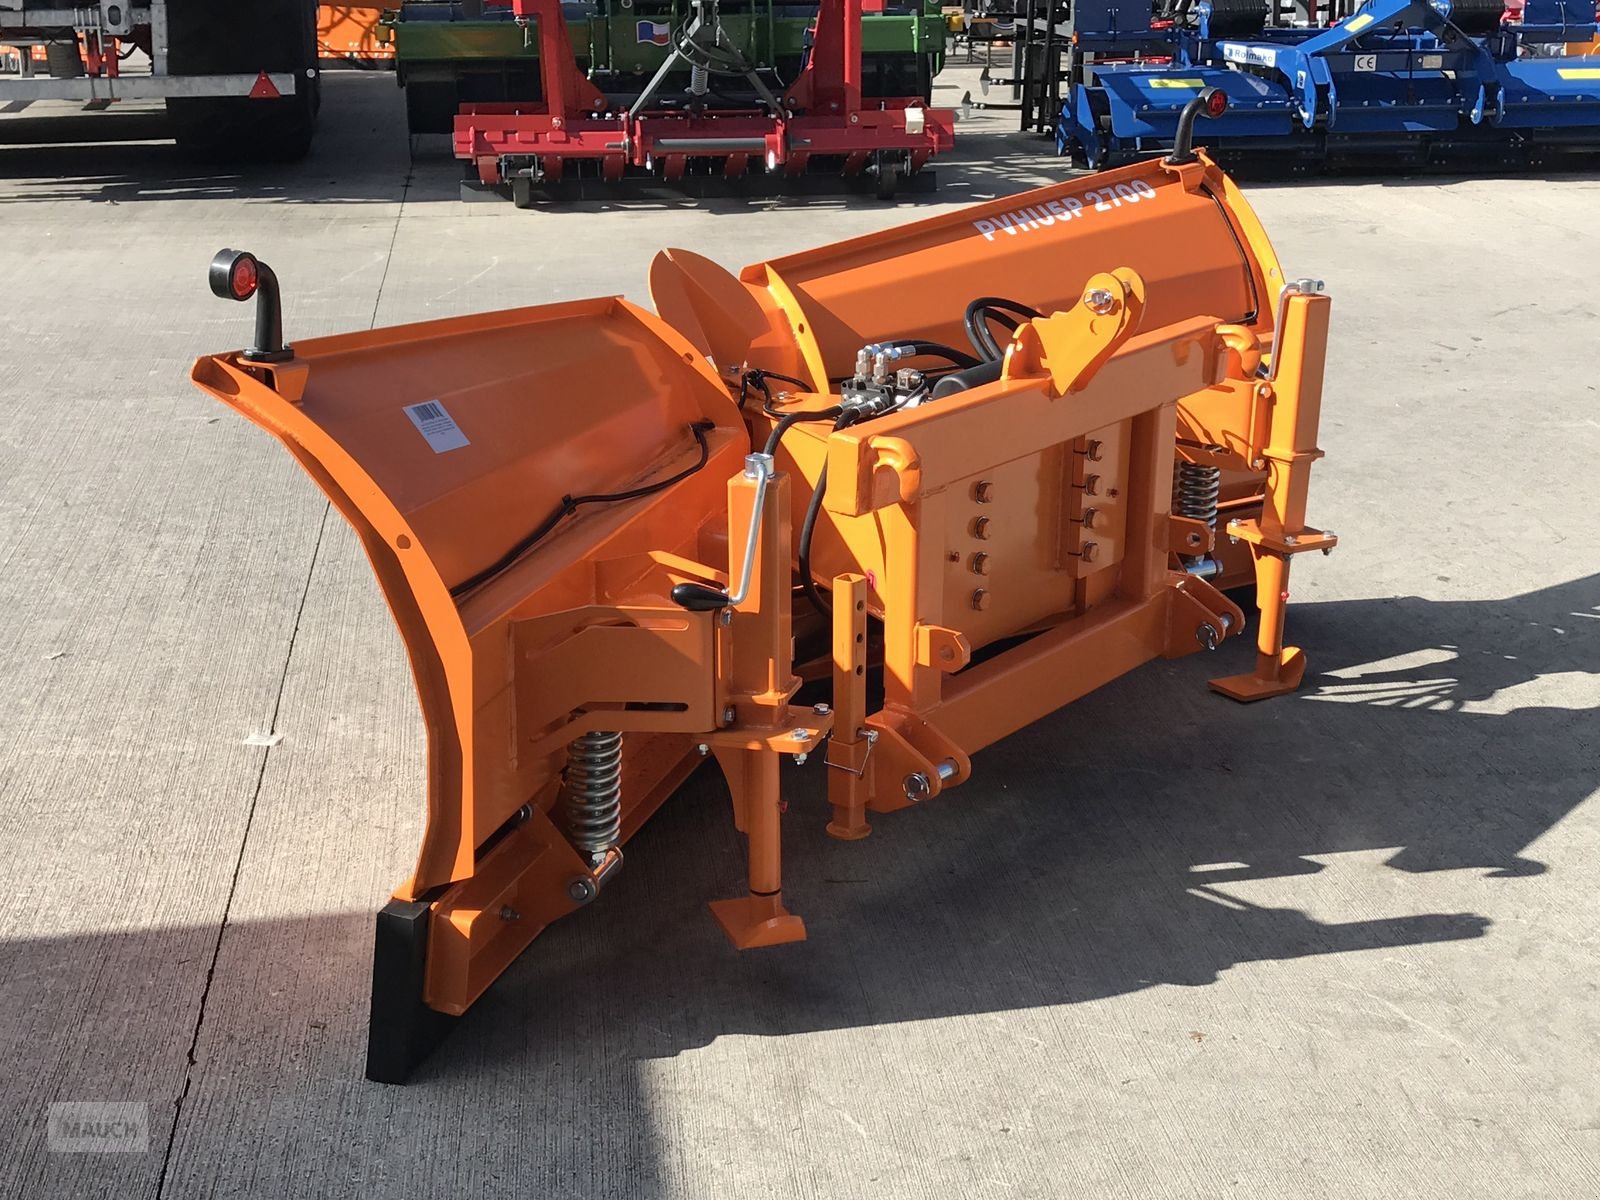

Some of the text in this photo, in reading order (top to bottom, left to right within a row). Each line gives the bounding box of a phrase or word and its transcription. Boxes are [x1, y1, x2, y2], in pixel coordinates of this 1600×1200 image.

[1234, 49, 1273, 62] Rolmako
[1357, 56, 1375, 70] CE
[1085, 179, 1157, 212] 2700
